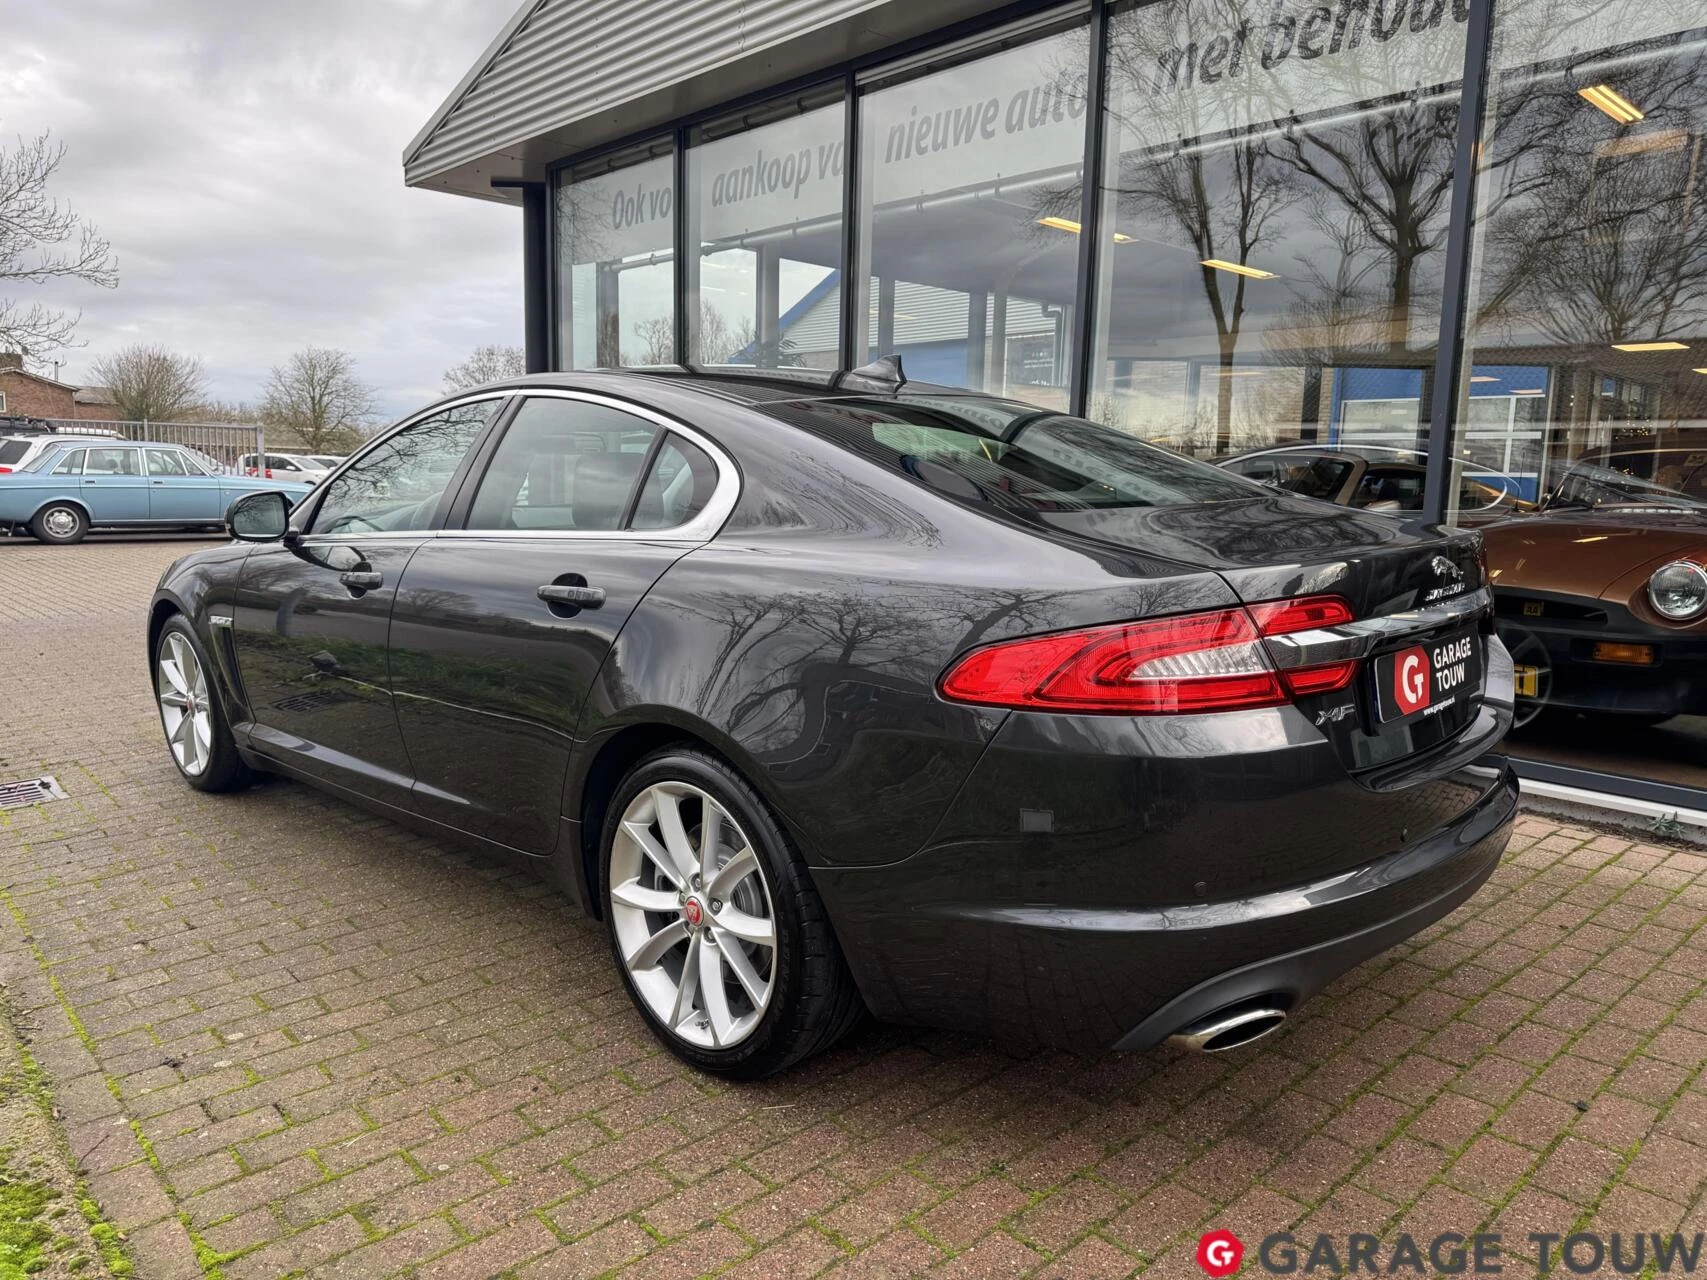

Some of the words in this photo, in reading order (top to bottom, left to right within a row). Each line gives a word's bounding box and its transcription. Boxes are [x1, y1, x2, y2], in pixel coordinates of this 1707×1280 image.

[613, 184, 645, 230] Ook
[650, 187, 672, 220] vo
[711, 148, 811, 207] aankoop
[885, 98, 1000, 164] nieuwe
[1433, 636, 1472, 669] GARAGE
[1435, 662, 1466, 692] TOUW
[1315, 703, 1356, 726] XF
